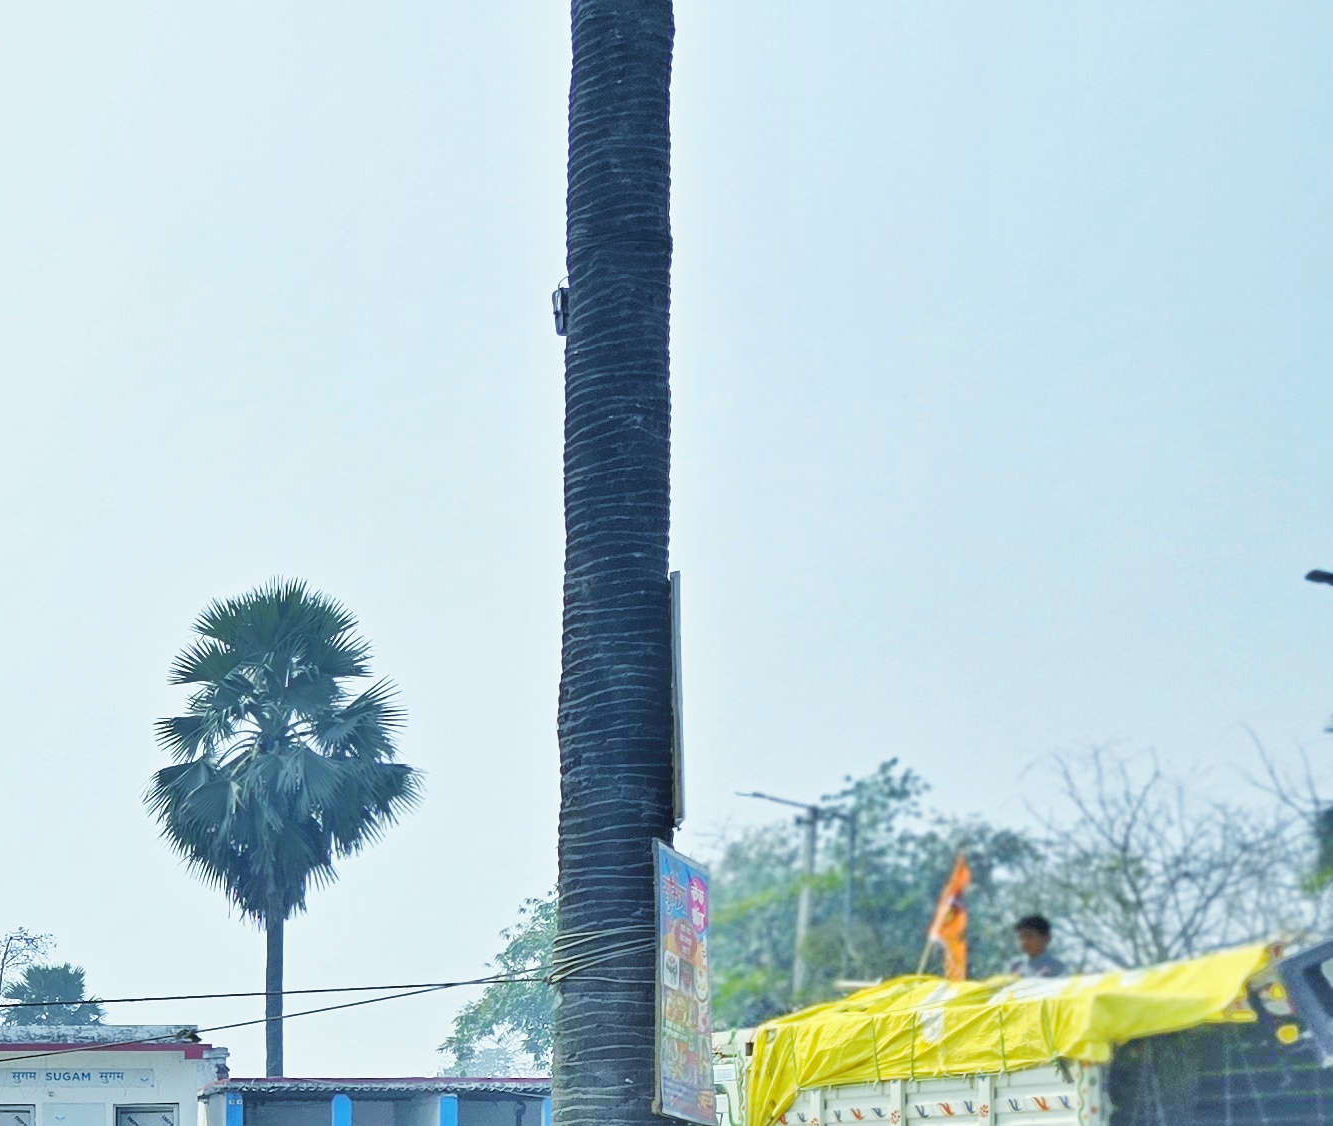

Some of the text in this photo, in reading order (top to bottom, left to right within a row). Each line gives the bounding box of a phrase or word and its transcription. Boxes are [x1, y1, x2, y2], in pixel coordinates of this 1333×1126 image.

[11, 1071, 37, 1084] सुगम
[45, 1072, 91, 1082] SUGAM
[99, 1071, 125, 1084] सुगम
